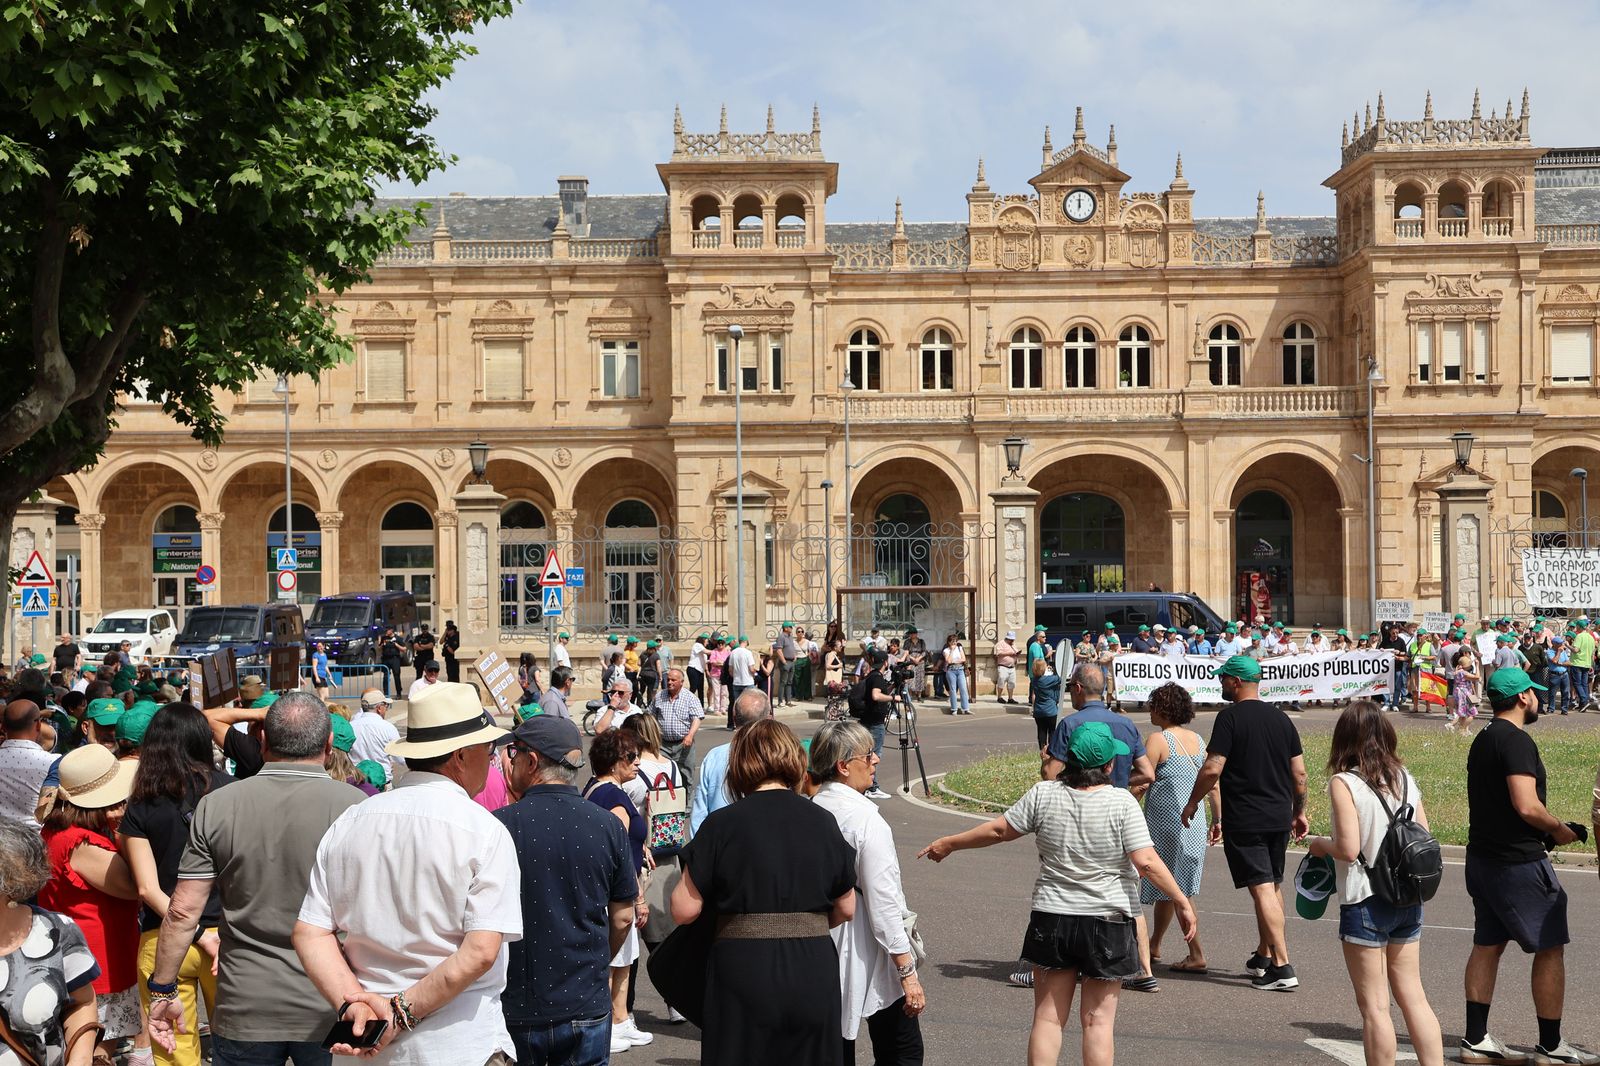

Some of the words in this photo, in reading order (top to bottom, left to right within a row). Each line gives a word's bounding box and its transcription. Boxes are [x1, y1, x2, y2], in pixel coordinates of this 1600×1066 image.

[1560, 548, 1591, 559] AVE
[1526, 561, 1539, 572] LO
[1545, 560, 1599, 572] PARAMOS
[1540, 590, 1563, 604] POR
[1571, 590, 1592, 604] SUS
[1115, 662, 1172, 679] PUEBLOS
[1175, 664, 1215, 680] VIVOS
[1261, 663, 1320, 680] ERVICIOS
[1323, 657, 1390, 676] PÚBLICOS
